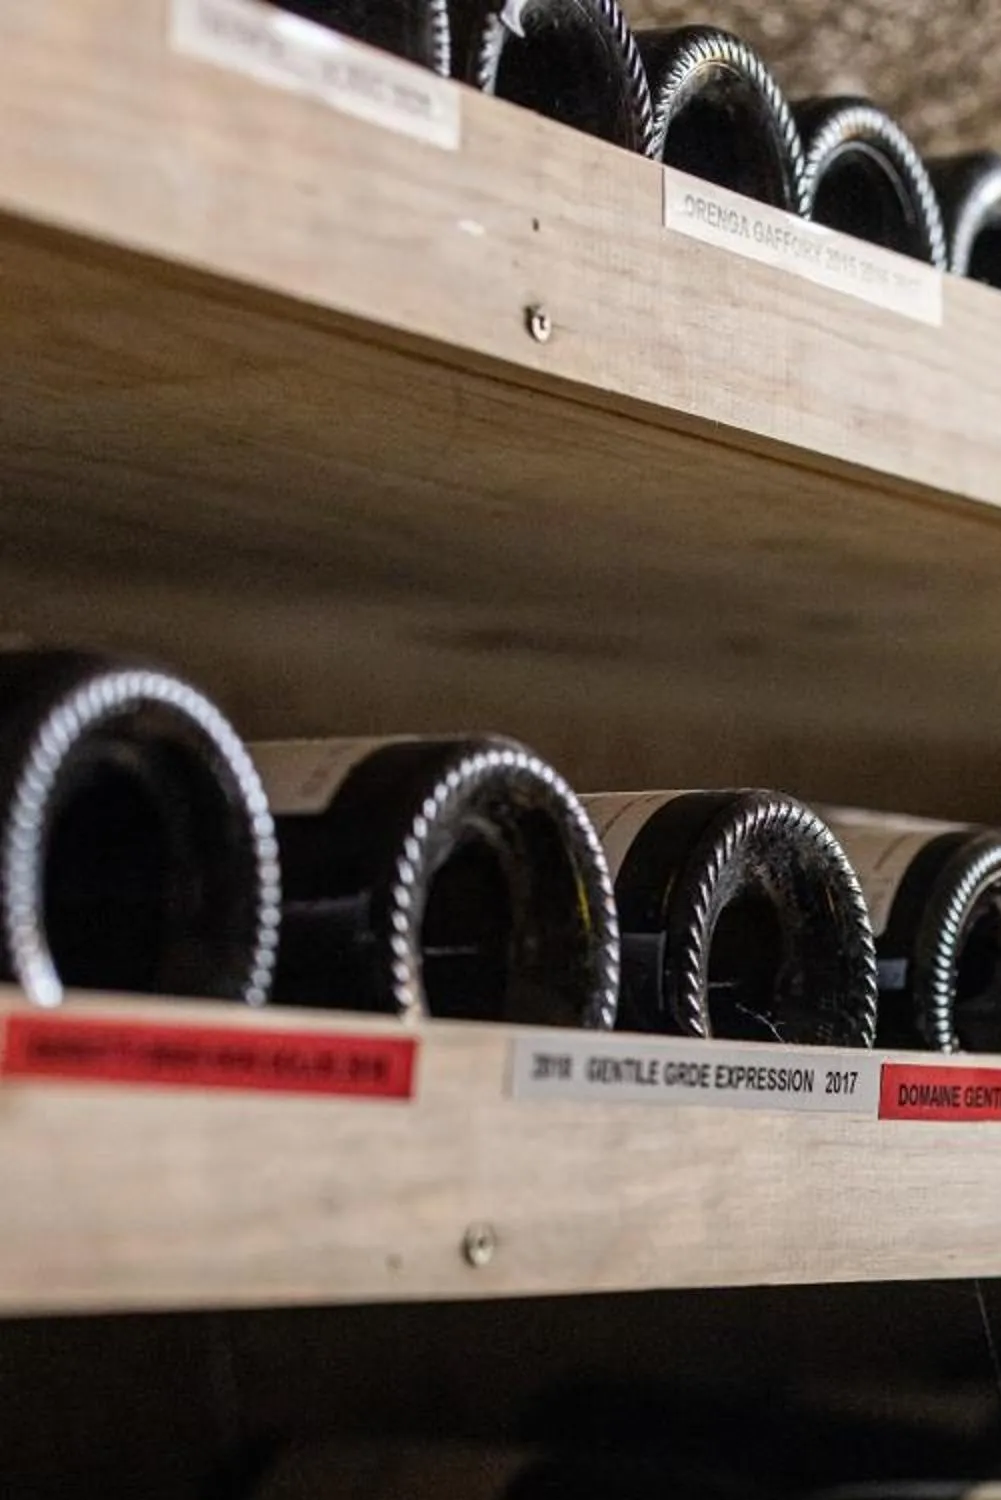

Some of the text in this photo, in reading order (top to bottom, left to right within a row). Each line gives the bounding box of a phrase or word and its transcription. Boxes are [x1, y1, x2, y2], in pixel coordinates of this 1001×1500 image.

[684, 194, 750, 239] ORENGA
[586, 1056, 659, 1086] GENTILE
[714, 1064, 815, 1093] EXPRESSION
[825, 1071, 859, 1094] 2017
[897, 1084, 962, 1108] DOMAINE
